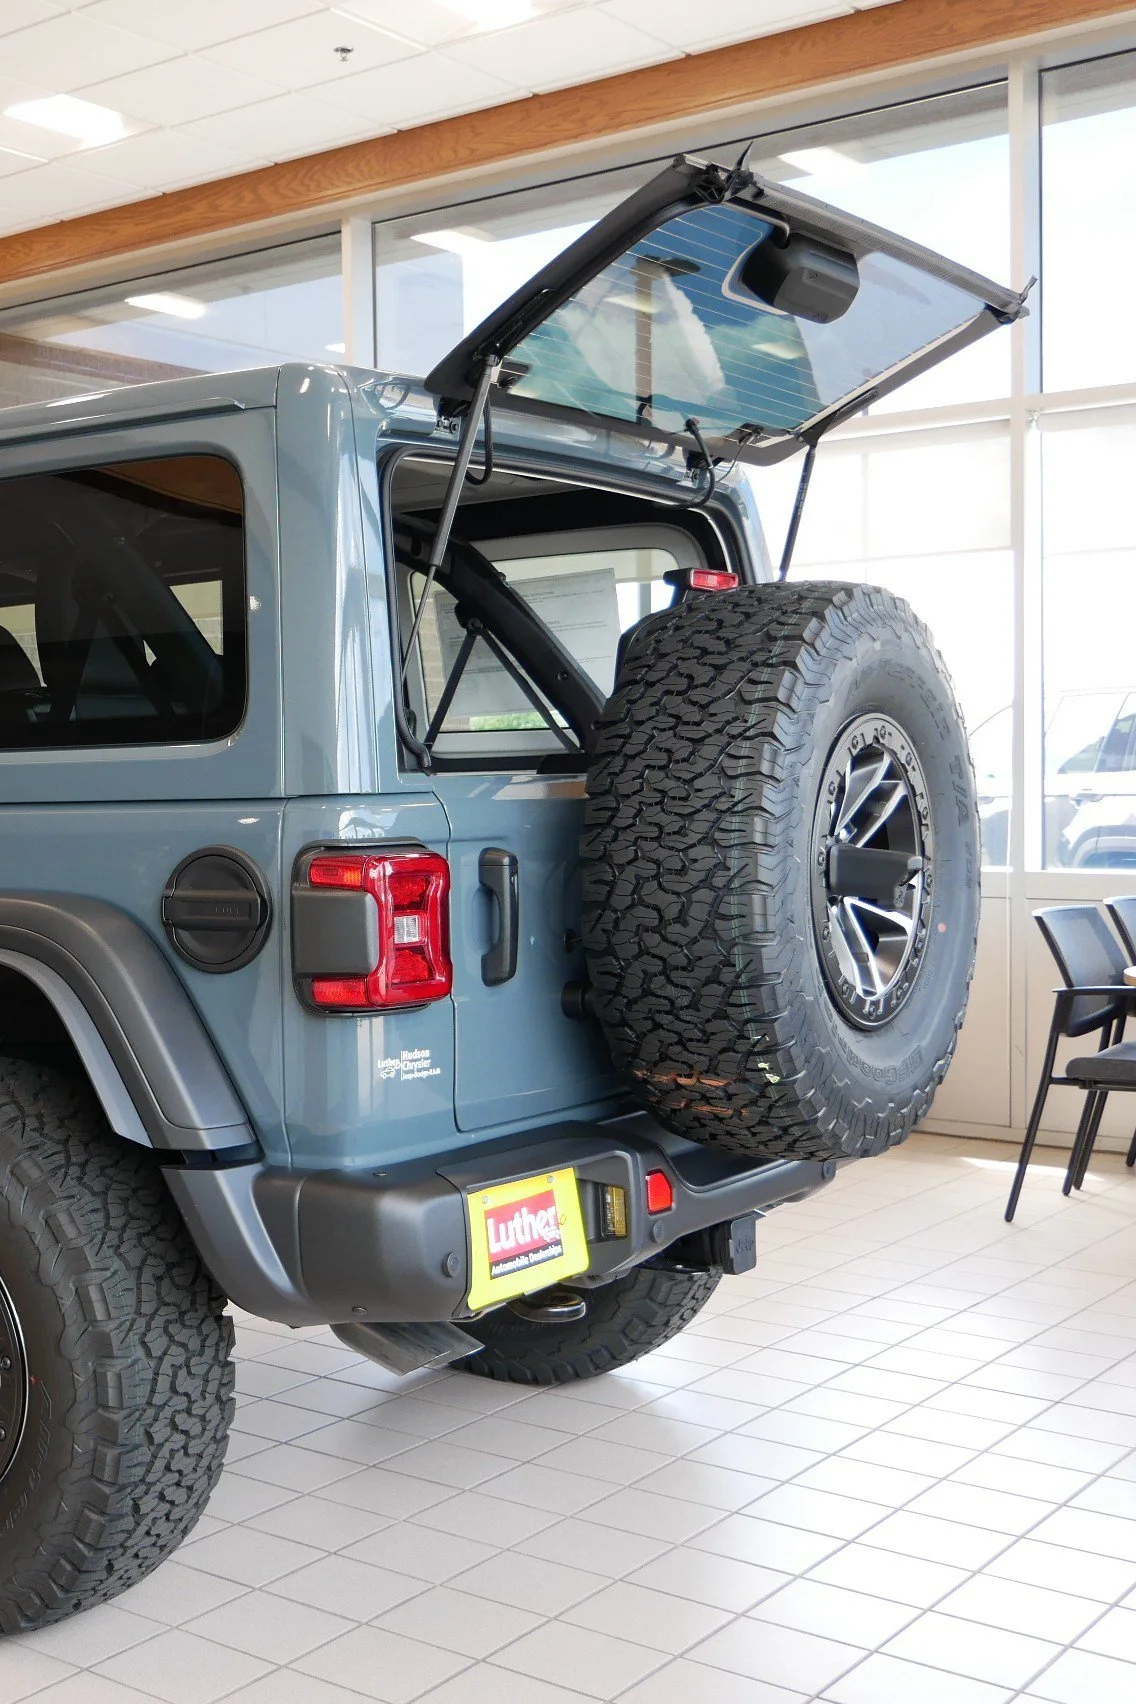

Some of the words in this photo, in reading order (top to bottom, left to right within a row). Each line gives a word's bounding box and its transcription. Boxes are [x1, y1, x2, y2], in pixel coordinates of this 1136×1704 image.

[402, 1048, 430, 1060] Hudson
[377, 1058, 401, 1070] Luther
[402, 1059, 432, 1072] Chrysler
[486, 1204, 557, 1254] Luther
[491, 1255, 529, 1277] Automobile
[528, 1243, 563, 1264] Dealerships
